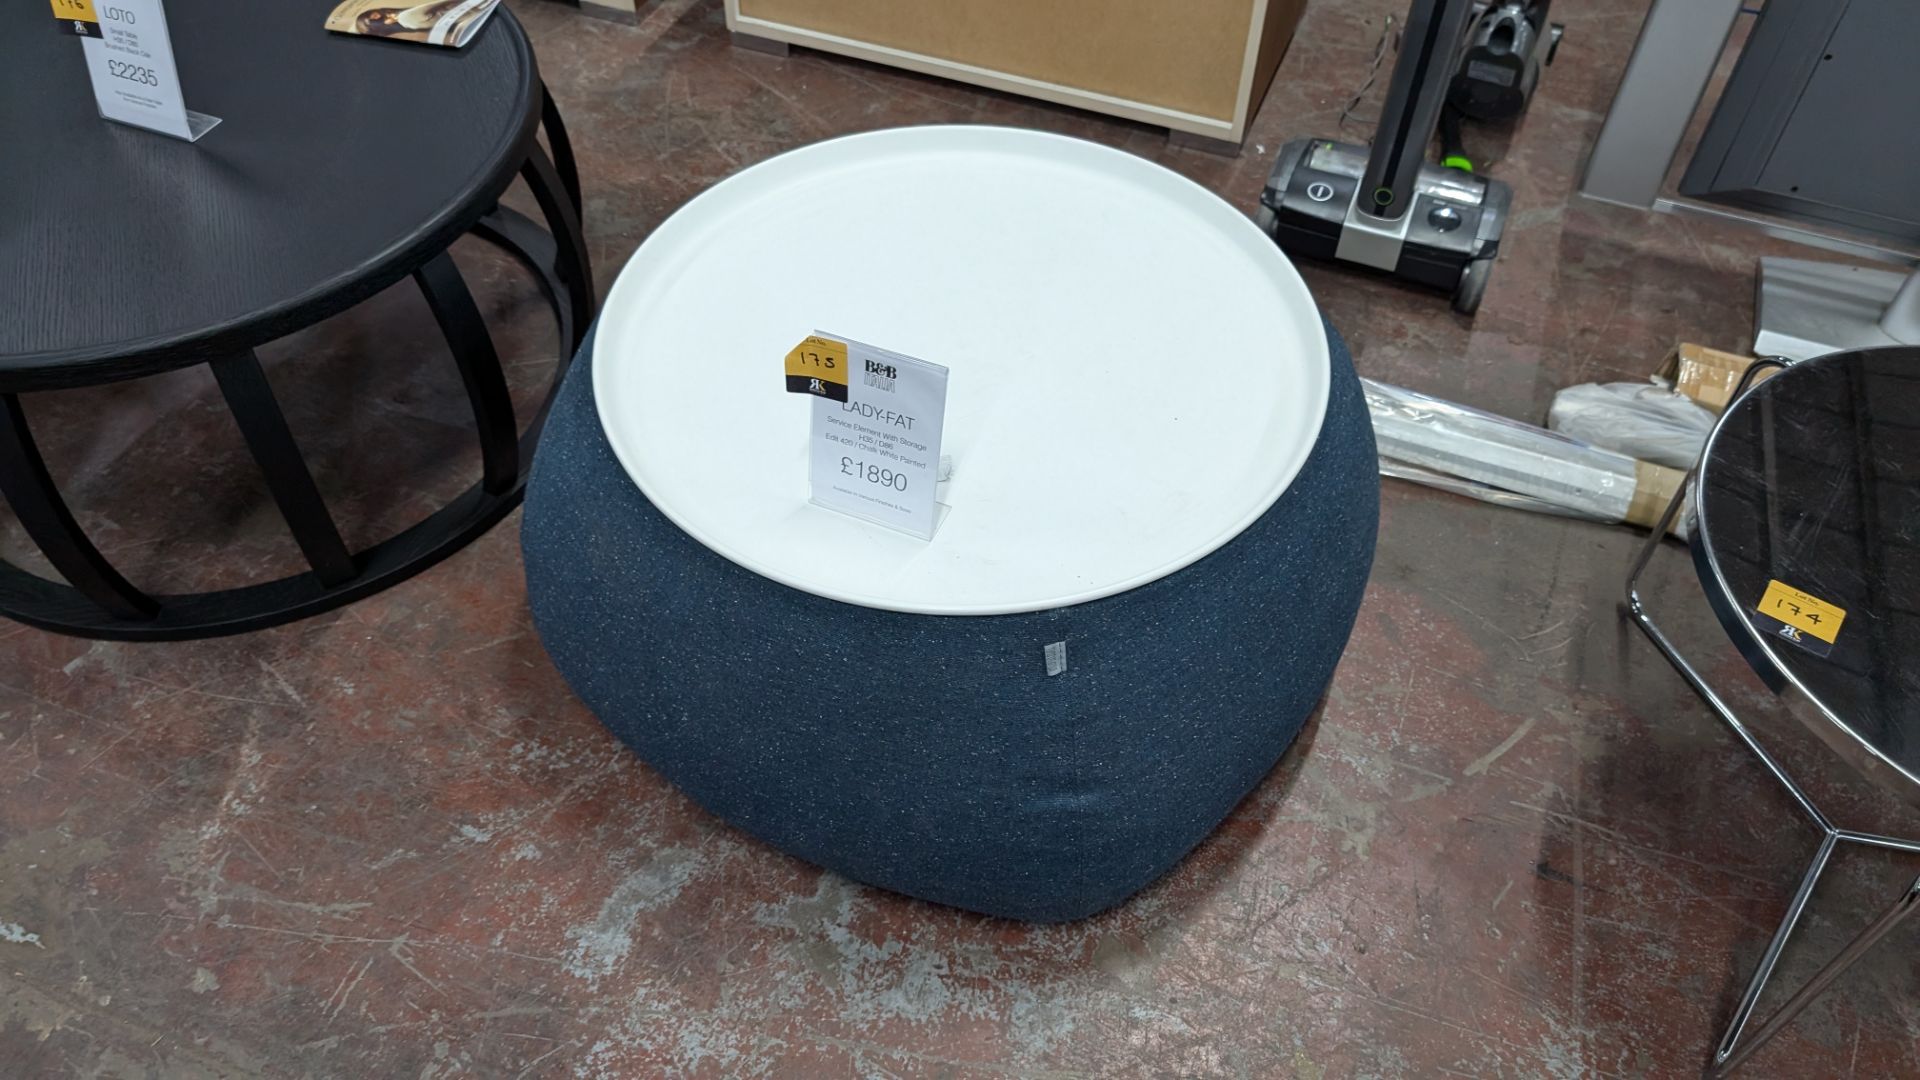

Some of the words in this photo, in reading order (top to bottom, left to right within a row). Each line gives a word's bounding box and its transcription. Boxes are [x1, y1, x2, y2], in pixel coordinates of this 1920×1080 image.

[103, 5, 136, 25] LOTO
[108, 59, 158, 87] £2235
[865, 359, 897, 379] B&B
[842, 401, 916, 430] LADY-FAT
[827, 415, 852, 429] Service
[854, 423, 881, 436] Element
[883, 432, 898, 442] With
[900, 437, 927, 451] Storage
[880, 449, 899, 460] White
[841, 456, 907, 492] £1890
[1777, 599, 1822, 625] 174
